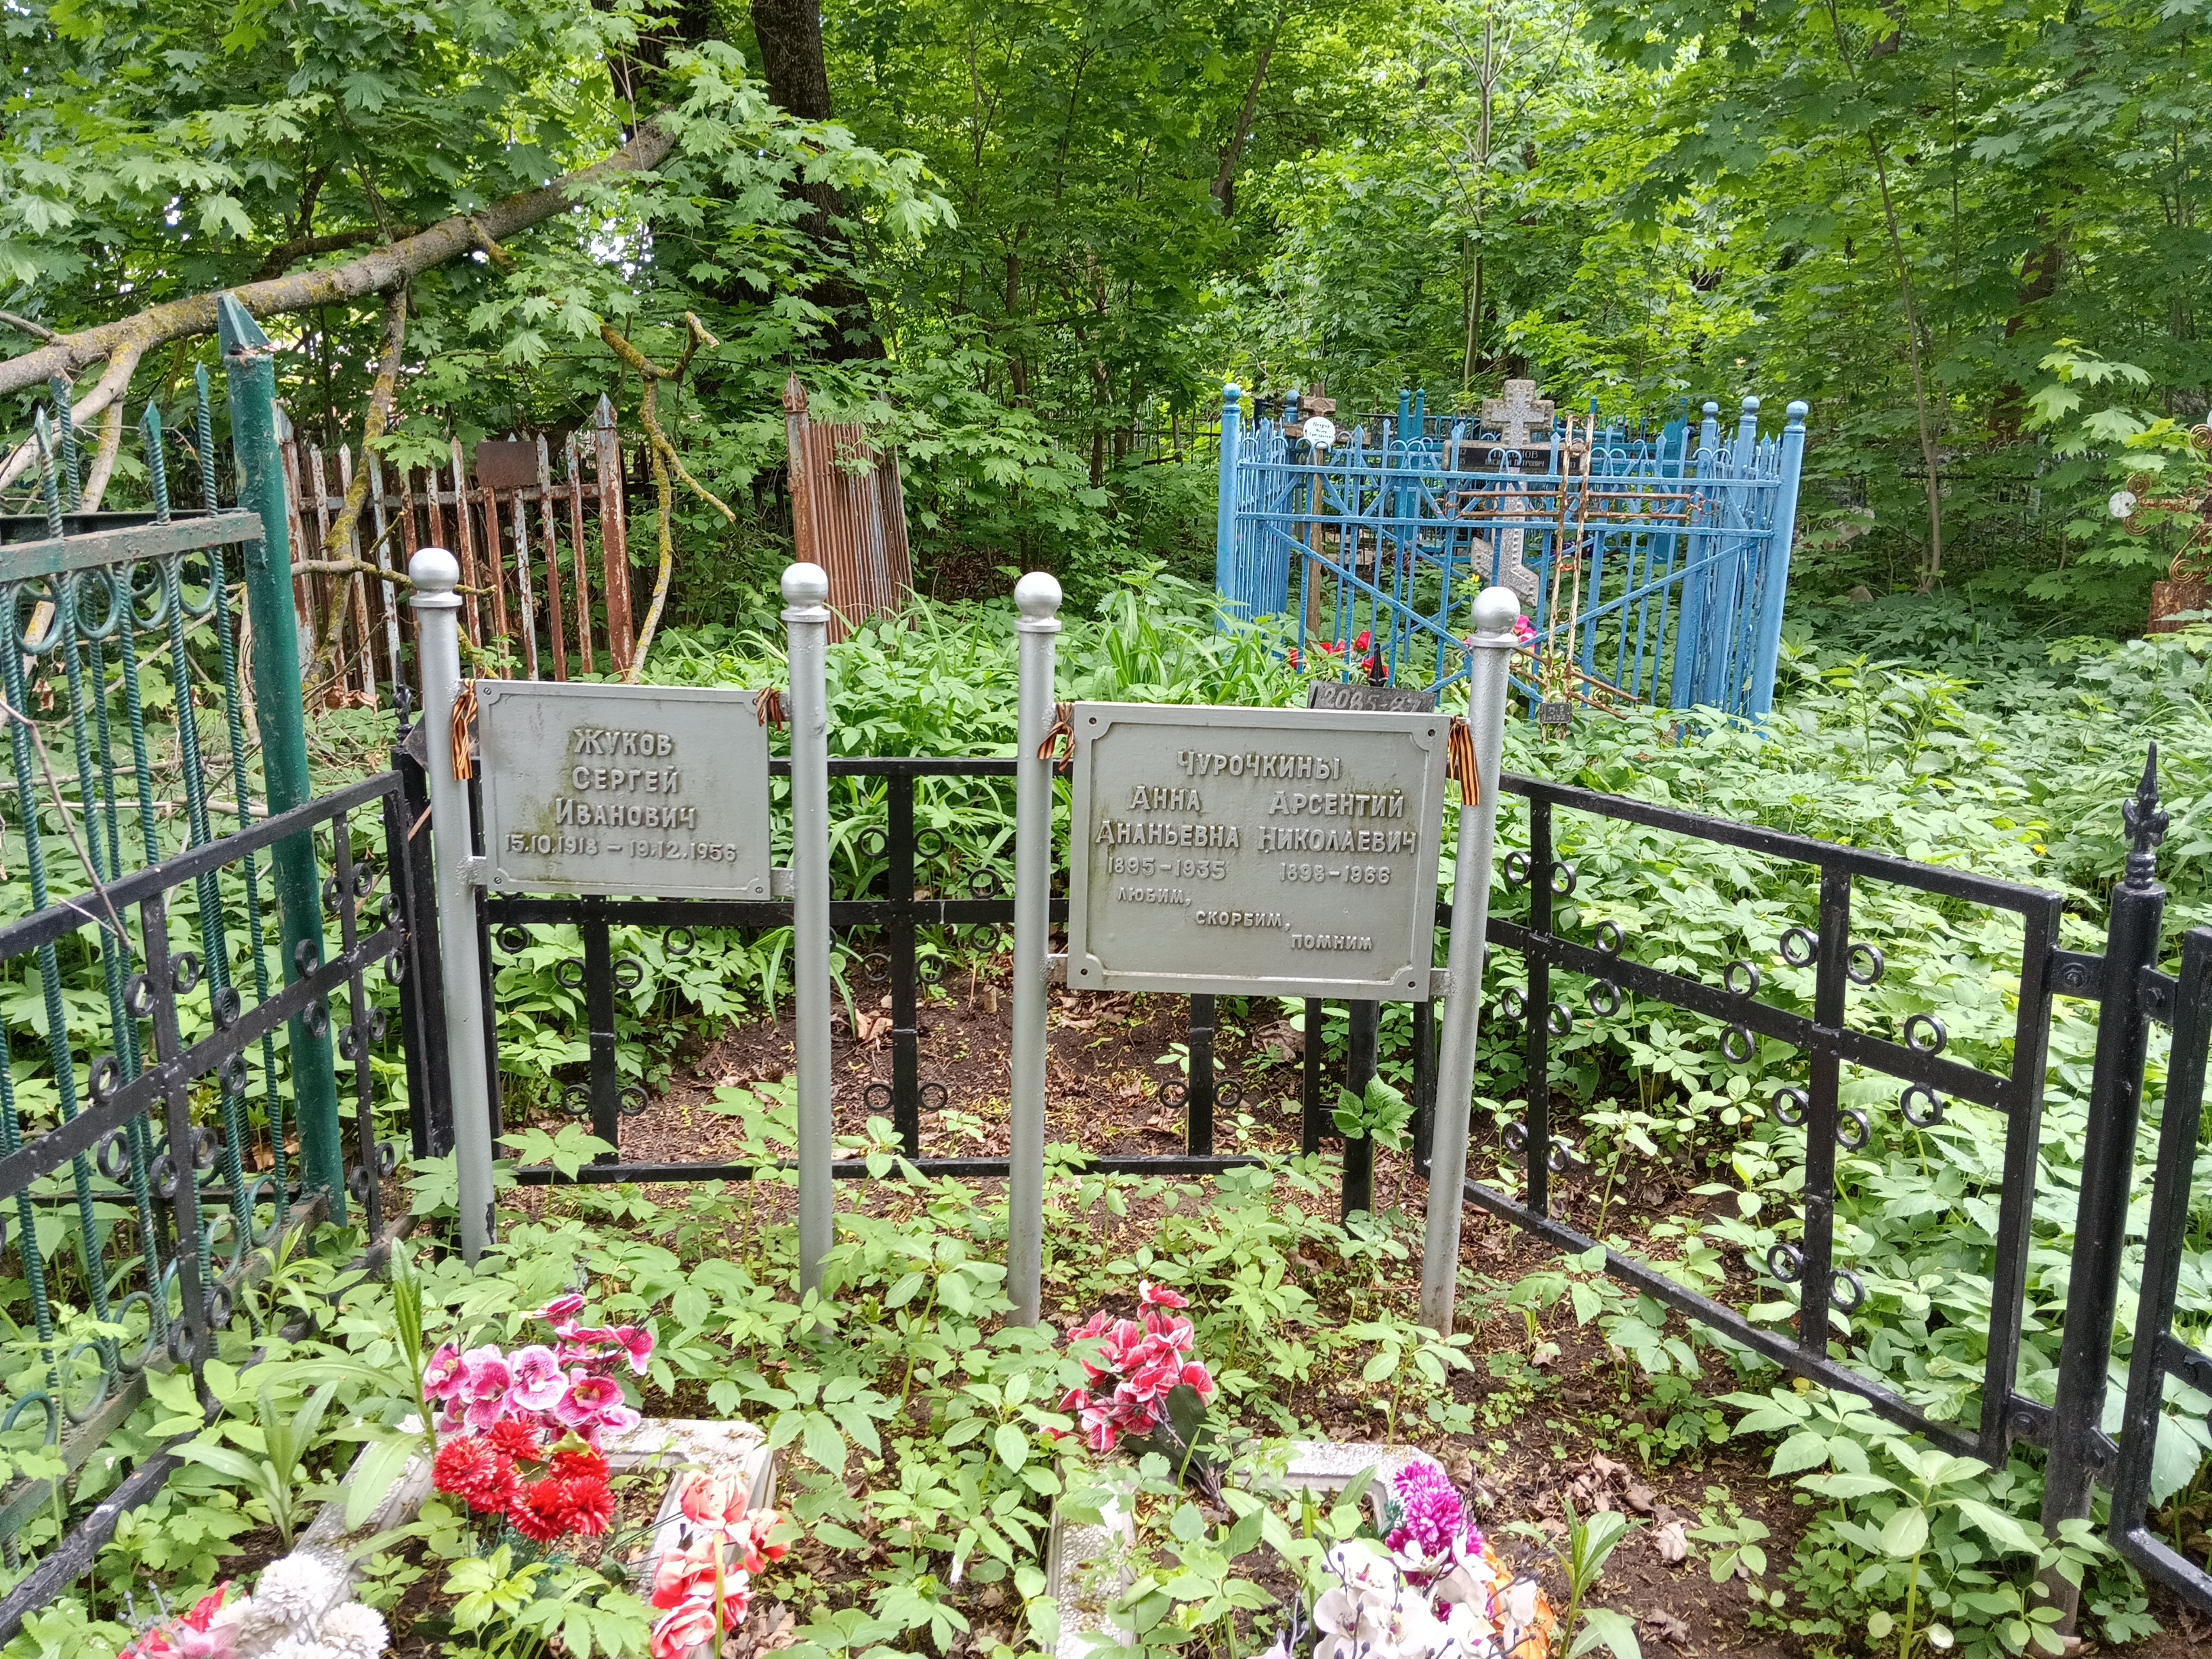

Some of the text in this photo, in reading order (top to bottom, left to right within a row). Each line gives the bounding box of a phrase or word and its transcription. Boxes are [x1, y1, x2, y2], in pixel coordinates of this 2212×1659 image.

[573, 729, 672, 756] ЖУКОВ
[573, 765, 679, 794] СЕРГЕЙ
[1176, 750, 1340, 781] ЧУРОЧКИНЫ
[556, 797, 696, 829] ИВАНОВИЧ
[1130, 785, 1201, 812] АННА
[1268, 790, 1404, 819] АРСЕНТИЙ
[1095, 821, 1240, 848] АНАНЬЕВНА
[1258, 825, 1417, 854] НИКОЛАЕВИЧ
[1291, 934, 1372, 950] ПОМНИМ
